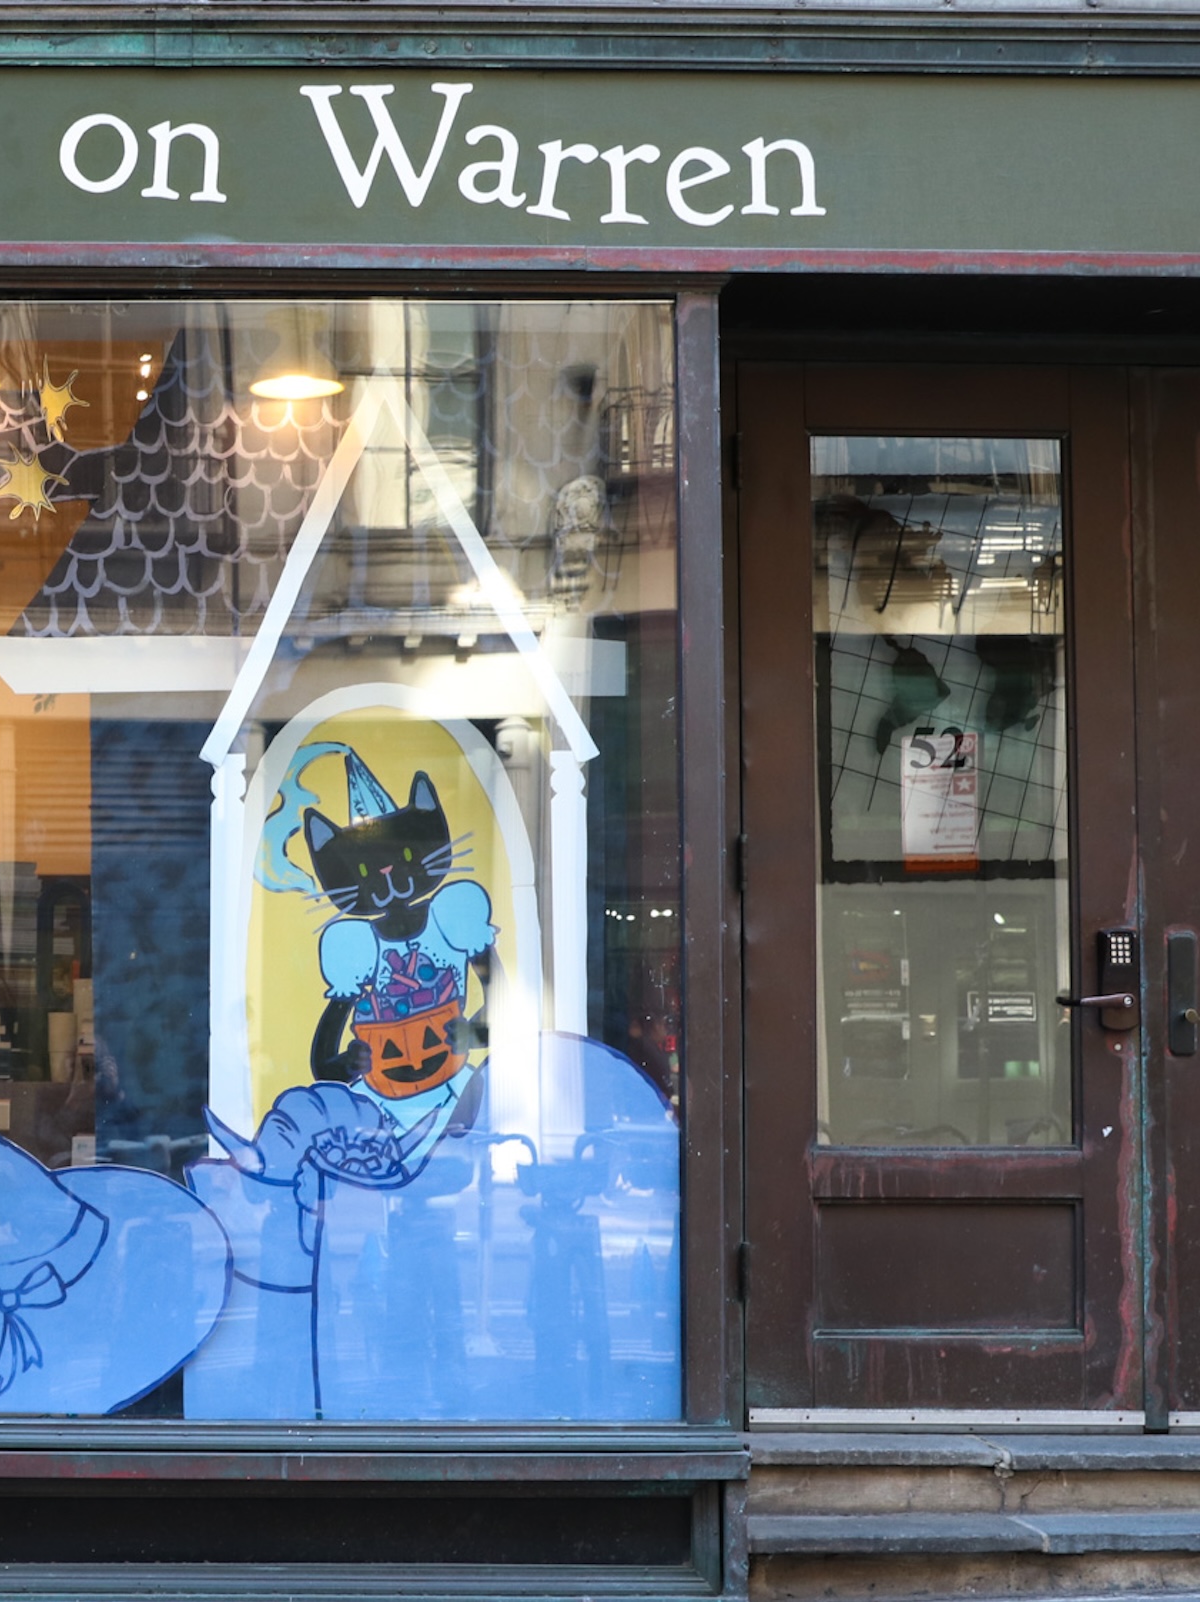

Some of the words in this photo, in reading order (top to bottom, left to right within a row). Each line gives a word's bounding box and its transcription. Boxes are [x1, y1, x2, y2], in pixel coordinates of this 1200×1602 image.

[59, 112, 228, 204] on
[299, 82, 827, 227] Warren
[909, 725, 967, 769] 52
